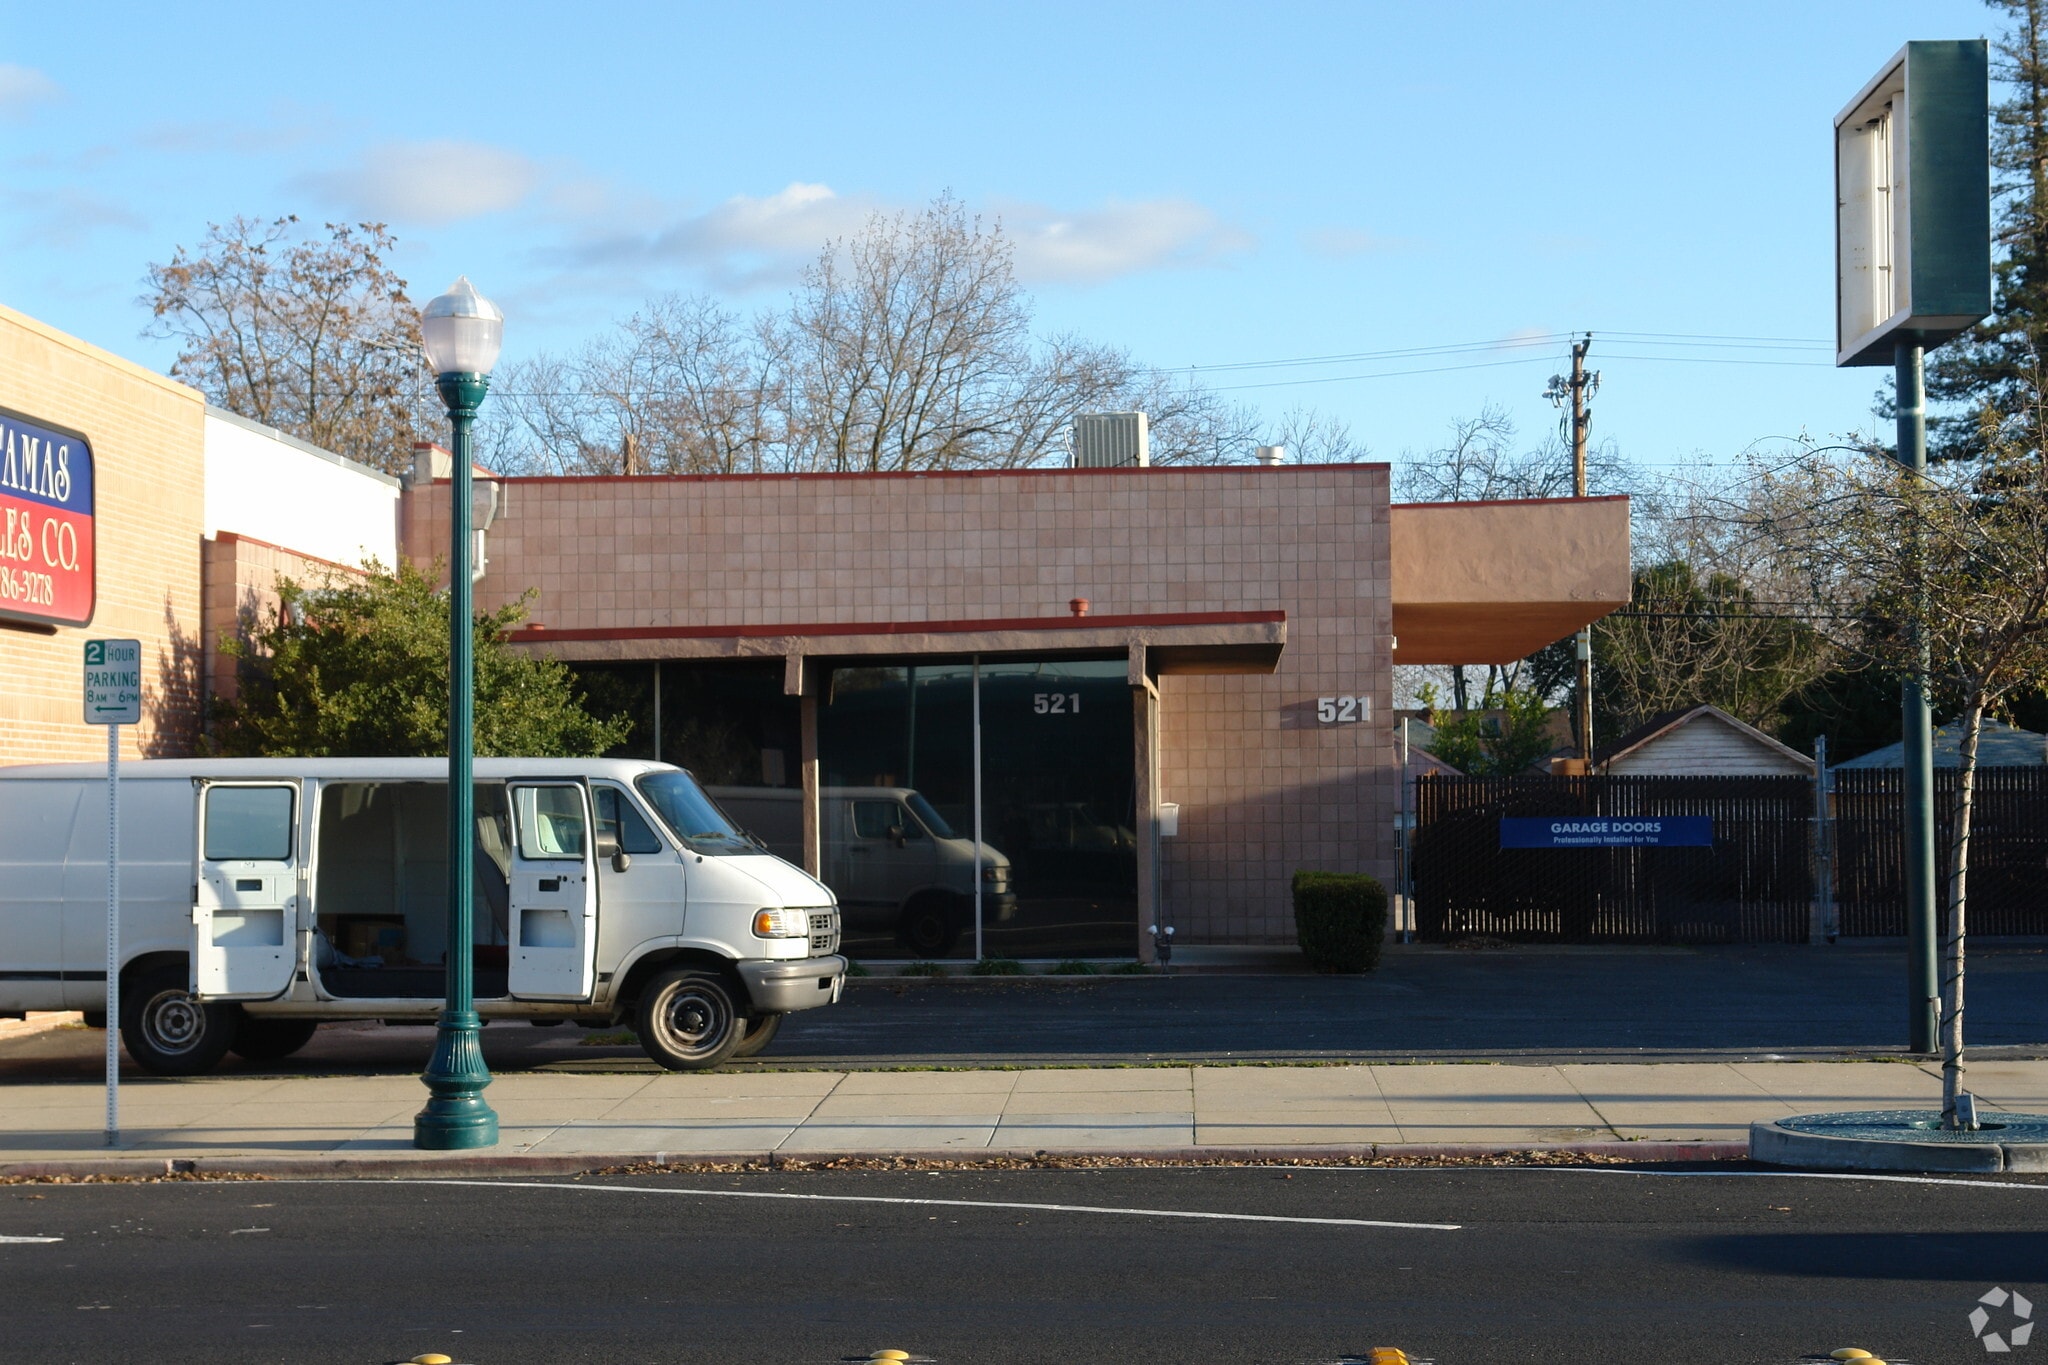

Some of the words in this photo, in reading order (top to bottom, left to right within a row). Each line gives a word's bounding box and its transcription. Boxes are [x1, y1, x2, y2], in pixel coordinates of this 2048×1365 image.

[41, 517, 80, 572] CO.
[0, 566, 53, 606] 86-3278
[87, 643, 101, 662] 2
[107, 647, 135, 661] HOUR
[87, 671, 137, 687] PARKING
[1033, 692, 1081, 714] 521
[1317, 695, 1372, 723] 521
[1551, 822, 1608, 833] GARAGE
[1612, 822, 1662, 833] DOORS
[1553, 836, 1602, 844] Professionally
